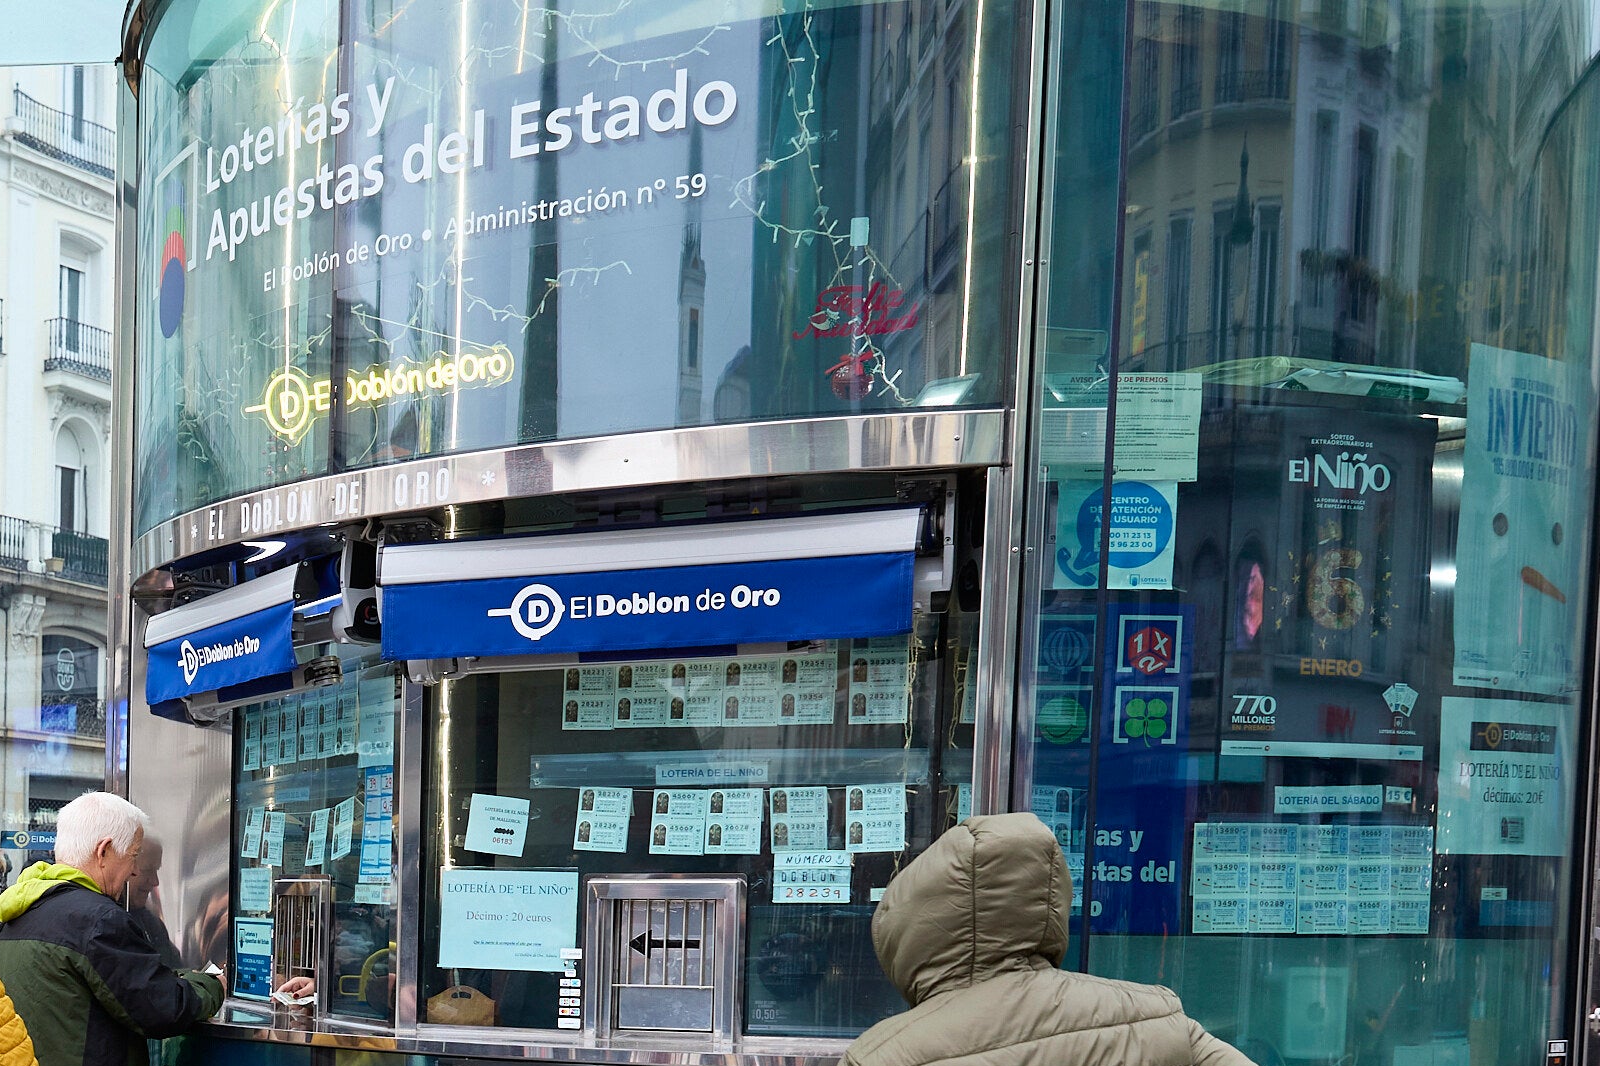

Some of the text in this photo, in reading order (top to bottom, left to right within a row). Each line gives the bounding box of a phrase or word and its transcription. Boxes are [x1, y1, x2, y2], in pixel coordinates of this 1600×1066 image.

[206, 76, 395, 194] Loterías y
[205, 68, 737, 261] Apuestas del Estado
[264, 269, 276, 292] El
[282, 251, 340, 284] Doblón
[346, 242, 368, 264] de
[375, 234, 412, 256] Oro
[443, 186, 626, 240] Administración
[675, 173, 706, 199] 59
[458, 353, 507, 382] Oro
[1288, 452, 1391, 495] El Niño
[208, 468, 450, 540] EL DOBLÓN DE ORO
[1111, 496, 1150, 504] CENTRO
[1111, 504, 1161, 513] ATENCIÓN
[570, 596, 592, 619] El
[596, 592, 689, 616] Doblon
[696, 588, 726, 611] de
[730, 584, 781, 608] Oro
[206, 642, 233, 663] Doblon
[234, 638, 244, 658] de
[244, 636, 260, 654] Oro
[57, 661, 75, 673] GOIKO
[1300, 658, 1363, 677] ENERO
[1232, 694, 1277, 715] 770
[1232, 715, 1276, 724] MILLONES
[661, 768, 704, 778] LOTERÍA
[739, 766, 764, 776] NIÑO
[1460, 761, 1509, 777] LOTERÍA
[1511, 764, 1524, 778] DE
[1525, 765, 1537, 778] EL
[1278, 794, 1339, 805] LOTERÍA DEL
[1388, 790, 1411, 800] 15 €
[1526, 791, 1544, 804] 20€
[492, 837, 512, 845] 06183
[1130, 830, 1144, 852] y
[786, 855, 832, 864] NÚMERO
[1140, 860, 1175, 882] del
[448, 882, 496, 894] LOTERÍA
[499, 884, 514, 894] DE
[786, 888, 841, 898] 28239
[466, 911, 551, 922] Décimo 20 euros
